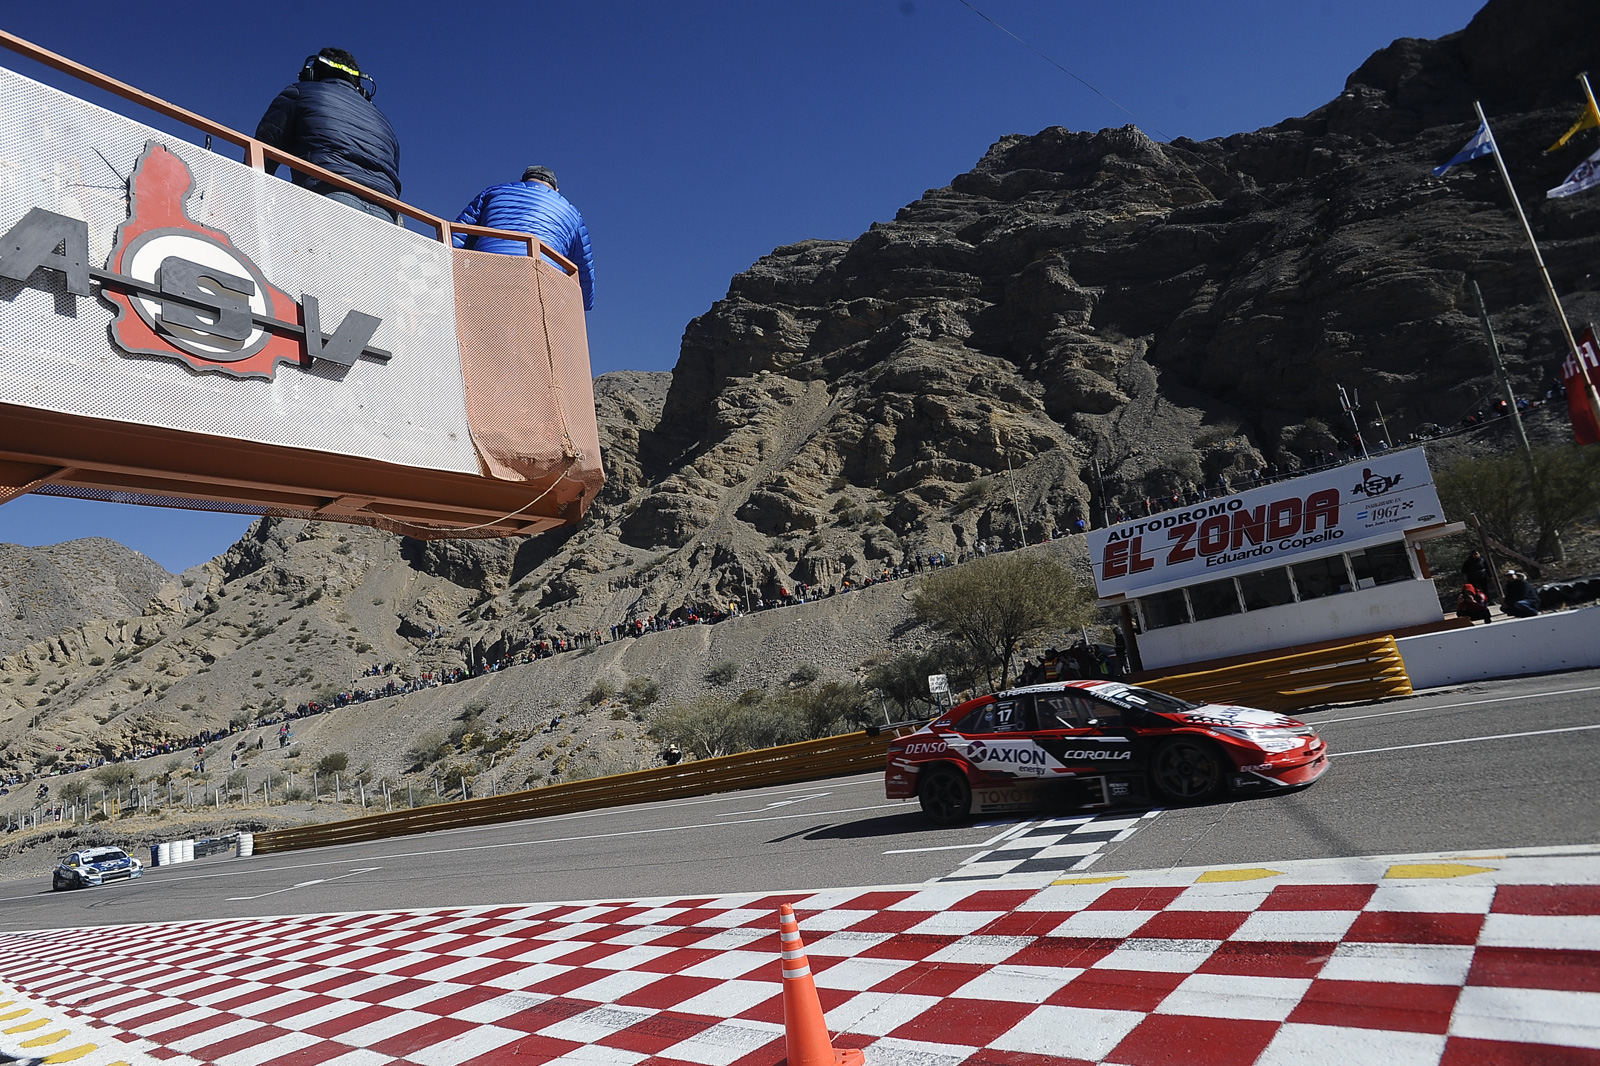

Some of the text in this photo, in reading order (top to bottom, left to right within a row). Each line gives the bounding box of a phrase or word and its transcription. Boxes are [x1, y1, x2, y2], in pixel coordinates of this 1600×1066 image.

[0, 207, 382, 367] ASV
[1371, 504, 1399, 521] 1967
[1389, 515, 1411, 523] Argentina
[1107, 499, 1243, 543] AUTODROMO
[1103, 488, 1340, 579] EL ZONDA
[1206, 529, 1344, 567] Eduardo Copello
[997, 708, 1013, 722] 17
[905, 742, 947, 755] DENSO
[988, 747, 1046, 765] AXION
[1064, 750, 1132, 760] COROLLA
[1019, 766, 1046, 775] energy
[1240, 763, 1273, 773] DENSO
